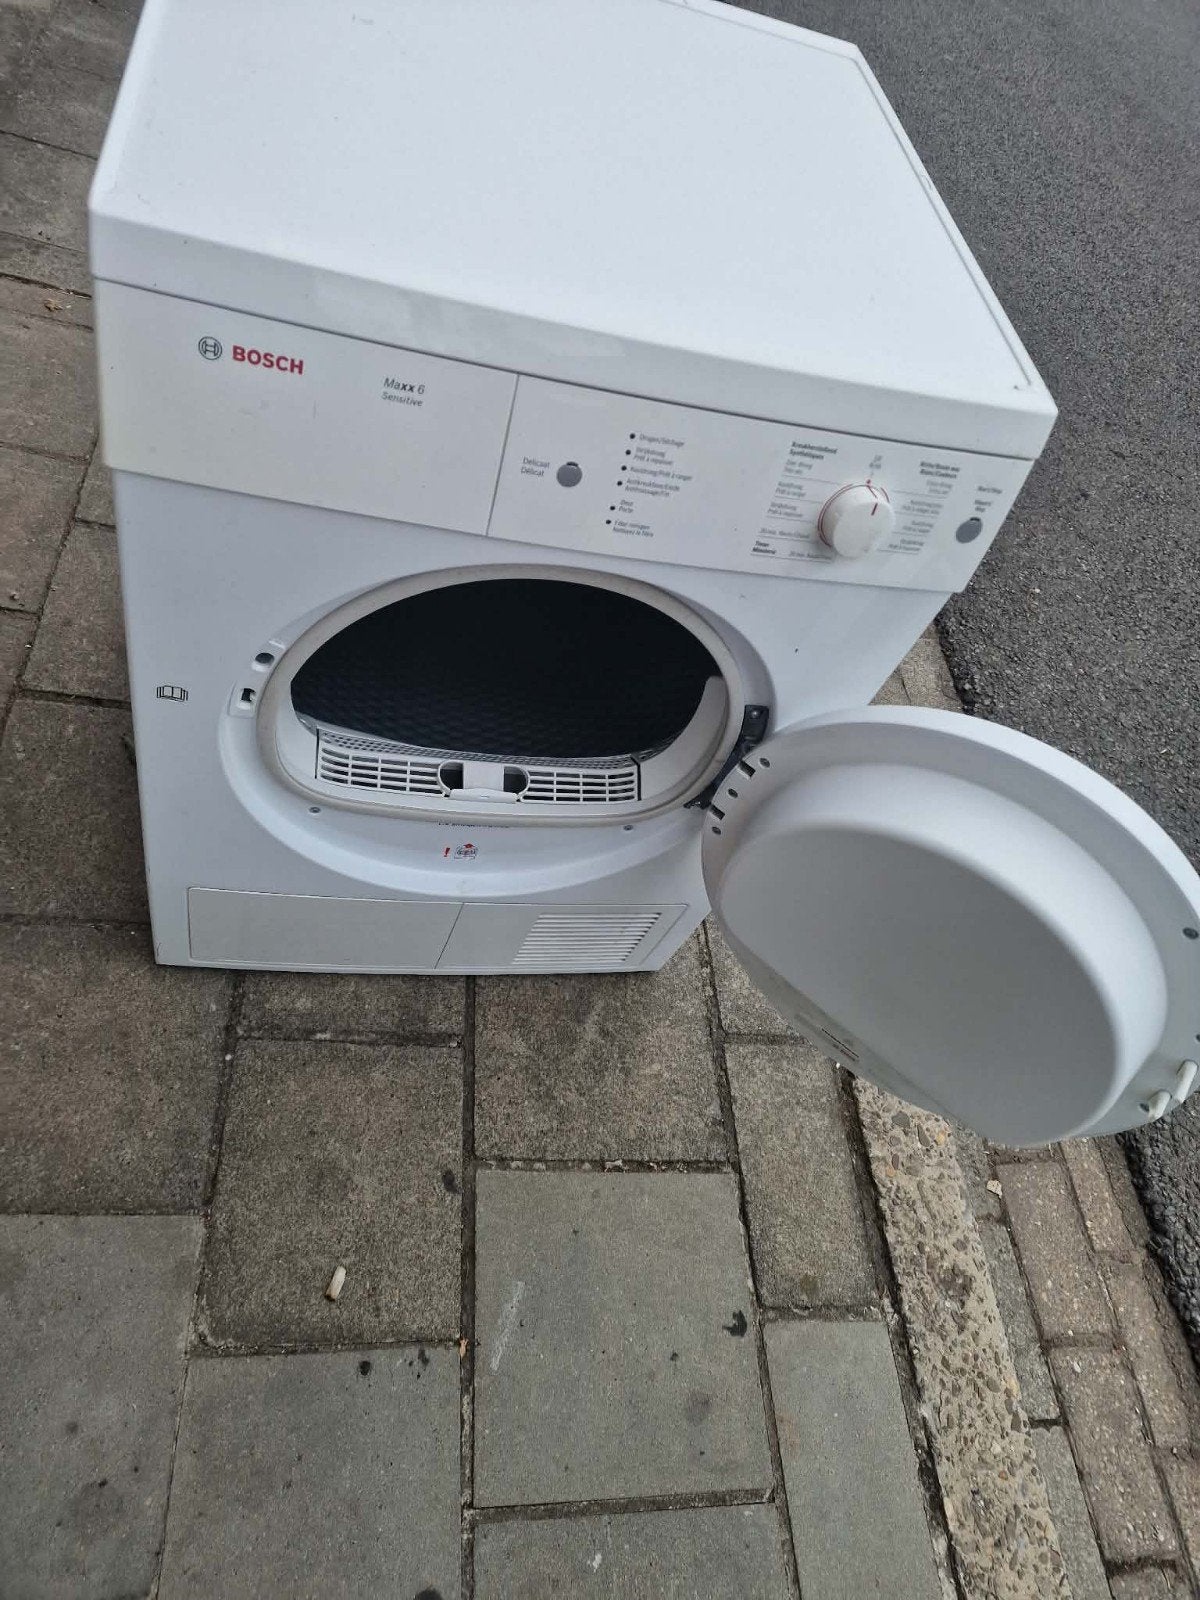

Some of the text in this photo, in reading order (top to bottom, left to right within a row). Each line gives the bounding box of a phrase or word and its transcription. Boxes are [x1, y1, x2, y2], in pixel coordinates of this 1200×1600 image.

[232, 344, 304, 375] BOSCH
[383, 377, 425, 395] Maxx 6
[381, 391, 424, 407] Sensitive
